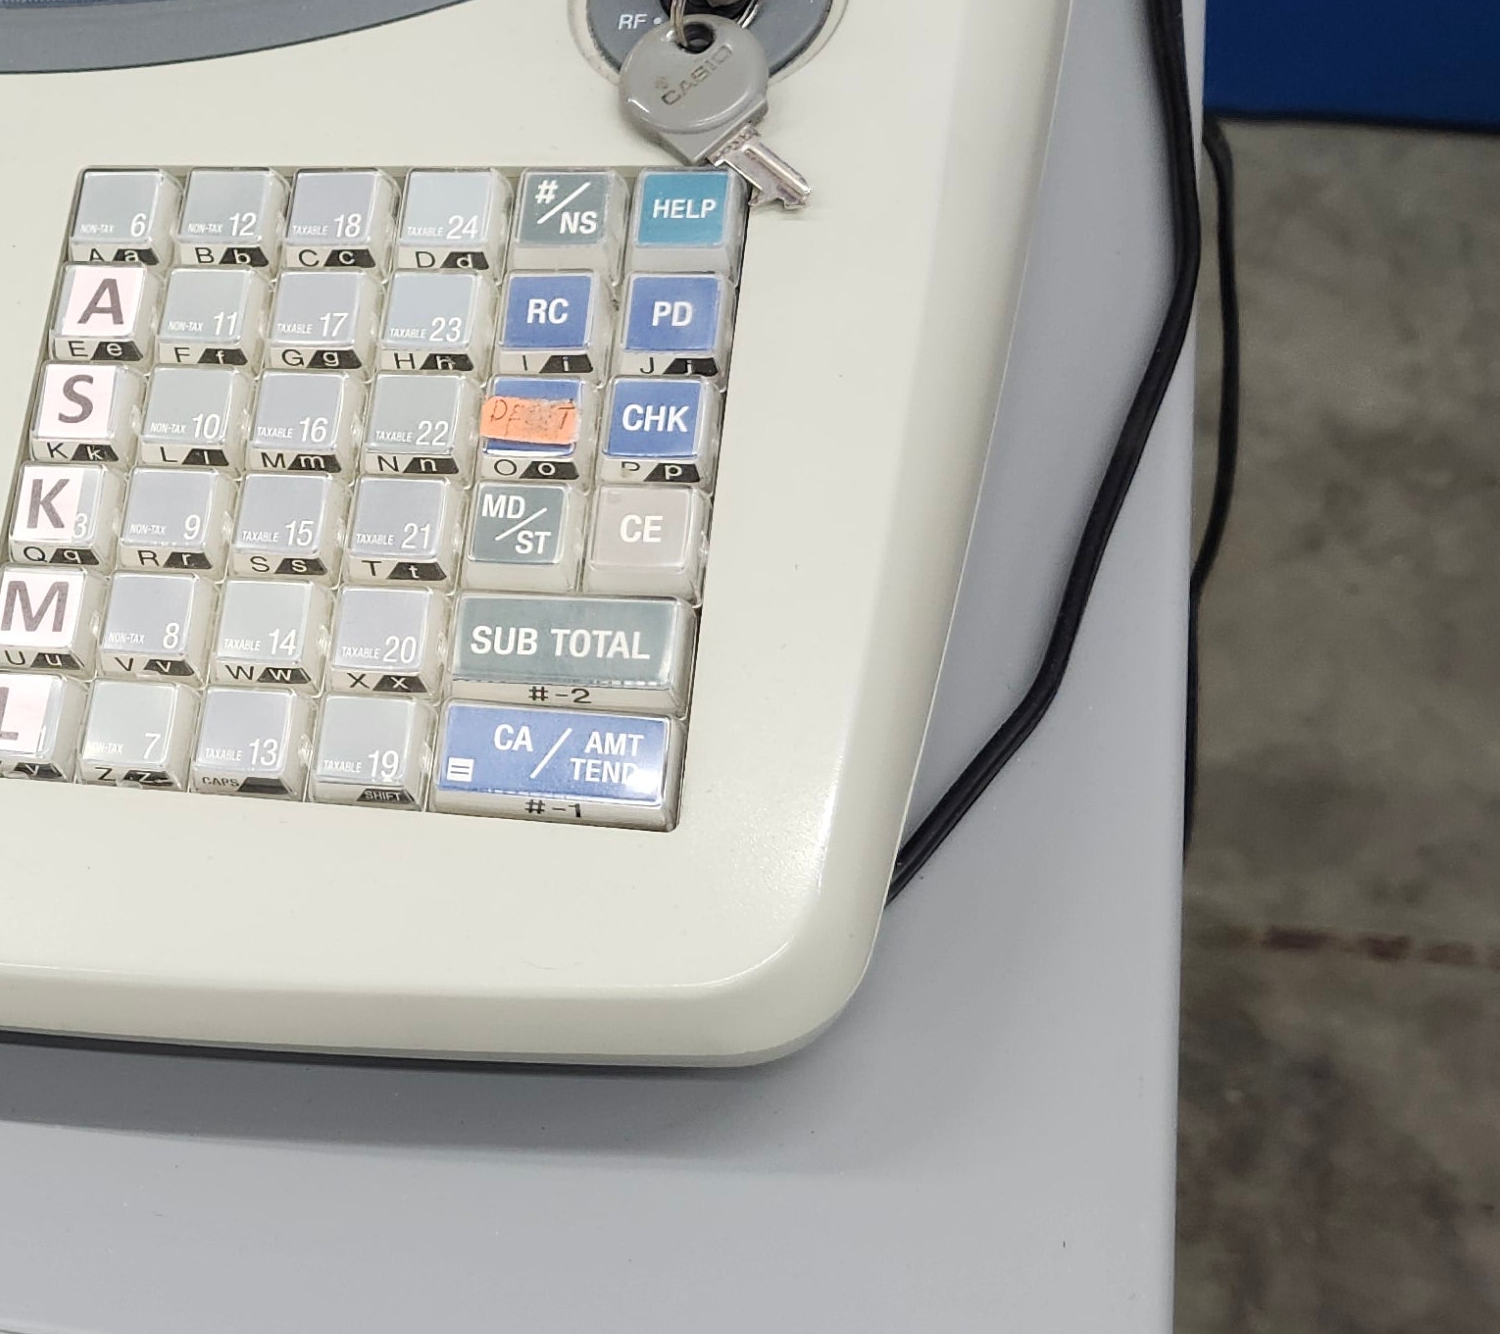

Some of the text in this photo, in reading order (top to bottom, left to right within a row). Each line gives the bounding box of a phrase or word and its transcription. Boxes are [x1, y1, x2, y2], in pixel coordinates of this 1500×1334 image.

[618, 14, 647, 29] RF
[661, 44, 733, 105] CASIO
[653, 199, 717, 219] HELP
[80, 214, 146, 237] NON-TAX 6
[187, 212, 256, 236] NON-TAX 12
[292, 214, 361, 237] TAXABLE 18
[407, 216, 479, 239] TAXABLE 24
[77, 278, 125, 325] A
[527, 299, 569, 325] RC
[652, 301, 693, 327] PD
[167, 312, 239, 335] NON-TAX 11
[276, 313, 349, 337] TAXABLE 17
[390, 317, 462, 342] TAXABLE 23
[58, 374, 94, 423] S
[150, 413, 221, 439] NON-TAX 10
[257, 418, 327, 442] TAXABLE 16
[622, 405, 689, 433] CHK
[375, 420, 449, 446] TAXABLE 22
[27, 478, 70, 529] K
[130, 515, 200, 540] NON-TAX 9
[242, 521, 314, 546] TAXABLE 15
[356, 523, 431, 549] TAXABLE 21
[620, 515, 663, 543] CE
[0, 580, 70, 633] M
[109, 623, 180, 648] NON-TAX 8
[224, 629, 297, 655] TAXABLE 14
[471, 626, 651, 660] SUB TOTAL
[341, 636, 417, 663] TAXABLE 20
[144, 733, 161, 758] 7
[205, 739, 278, 766] TAXABLE 13
[494, 724, 644, 757] CA AMT
[323, 750, 399, 780] TAXABLE 19
[202, 777, 240, 789] CAPS
[362, 789, 402, 802] SHIFT
